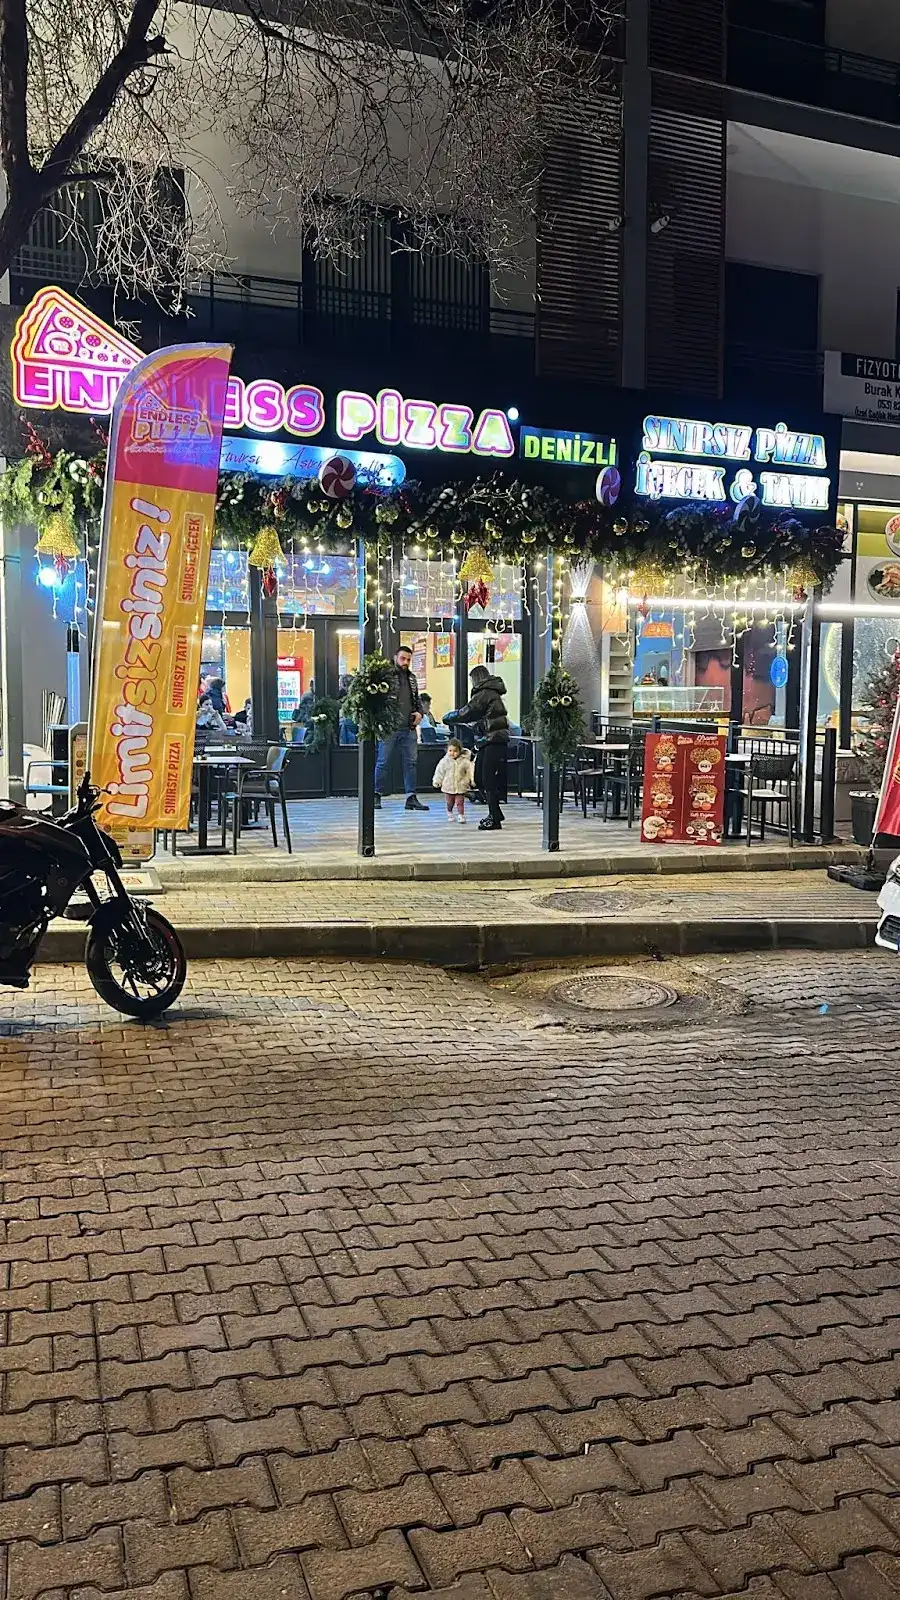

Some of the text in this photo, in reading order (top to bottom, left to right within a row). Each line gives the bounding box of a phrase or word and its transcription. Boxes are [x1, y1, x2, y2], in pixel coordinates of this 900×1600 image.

[864, 382, 892, 398] Burak
[139, 410, 200, 427] ENDLESS
[643, 415, 827, 469] SINIRSIZ PİZZA
[524, 434, 617, 466] DENİZLİ
[634, 451, 727, 501] İÇECEK
[729, 468, 757, 503] &
[181, 518, 201, 601] SINIRSIZ İÇECEK
[105, 497, 171, 819] Limitsizsiniz!
[172, 634, 188, 708] SINIRSIZ TATLI
[164, 741, 181, 815] SINIRSIZ PİZZA
